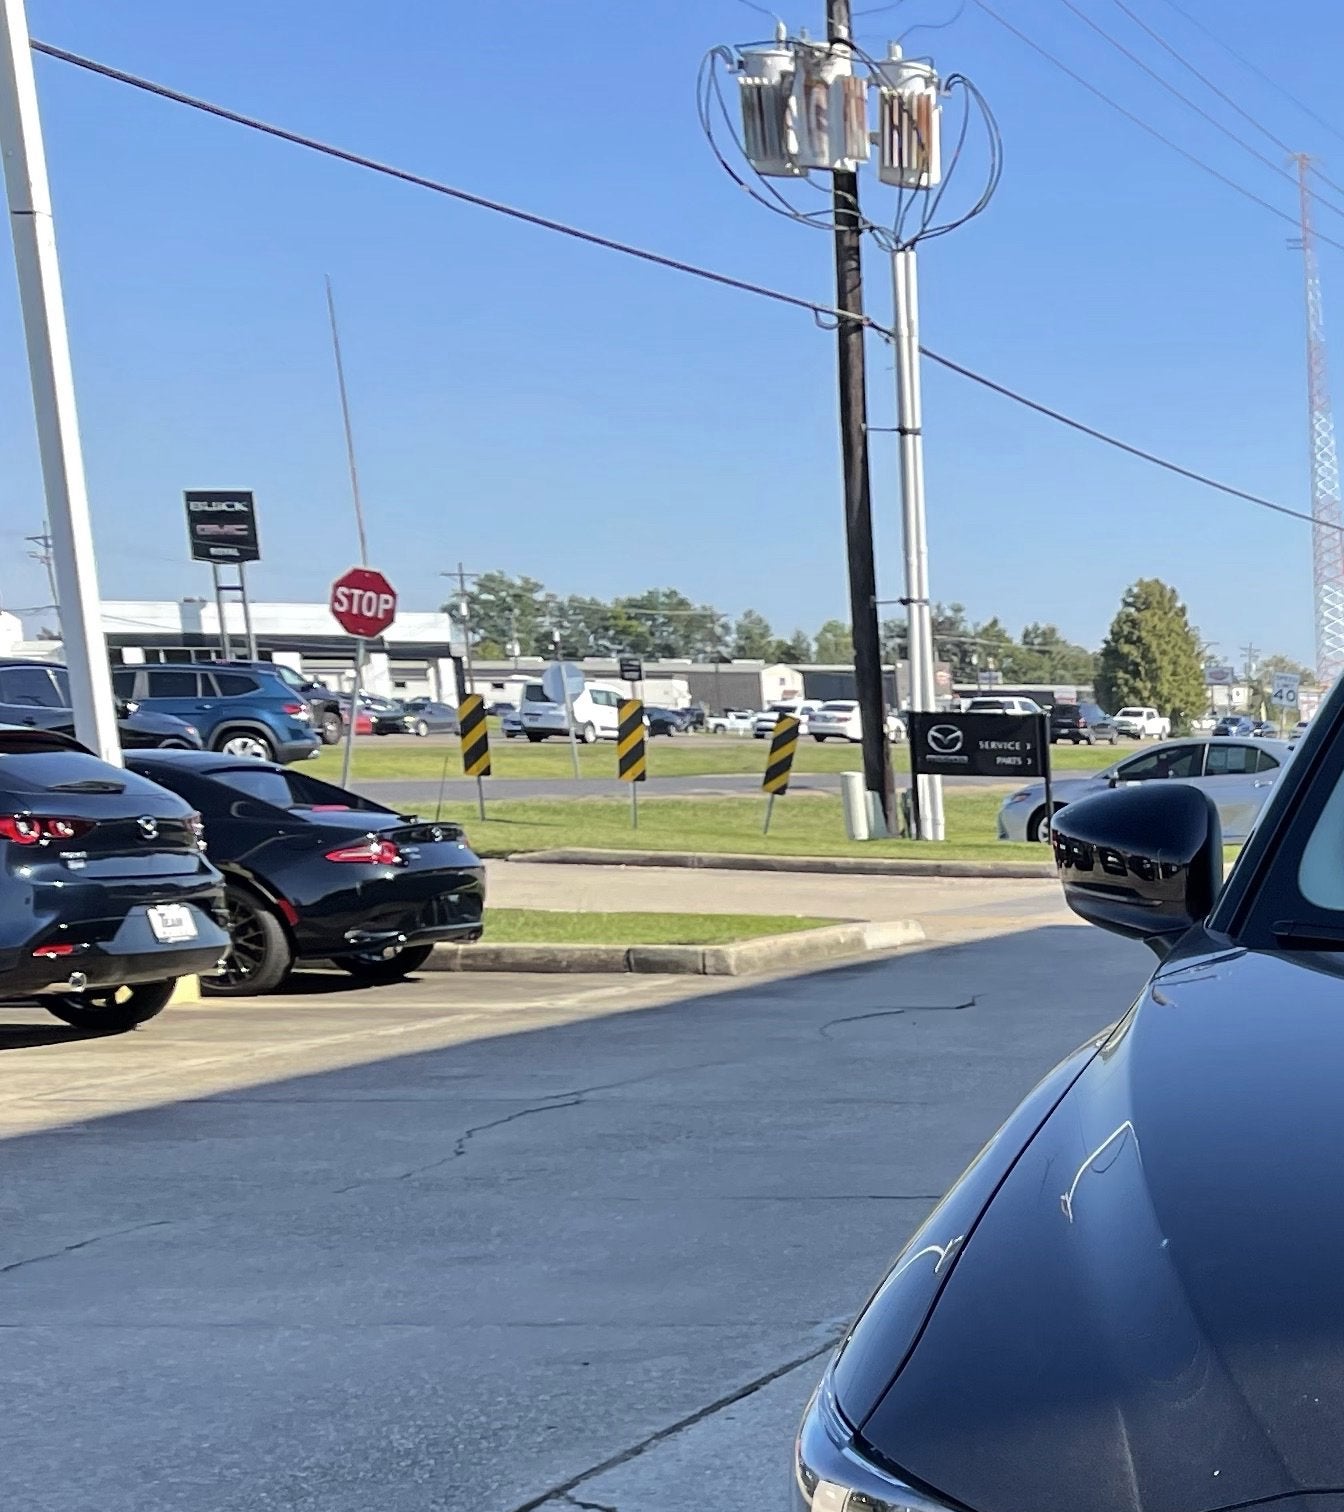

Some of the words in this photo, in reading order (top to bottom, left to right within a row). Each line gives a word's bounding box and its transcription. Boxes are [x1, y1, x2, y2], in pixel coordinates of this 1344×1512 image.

[334, 586, 394, 619] STOP
[1273, 688, 1296, 702] 40
[979, 740, 1021, 751] SERVICE
[996, 756, 1022, 765] PARTS
